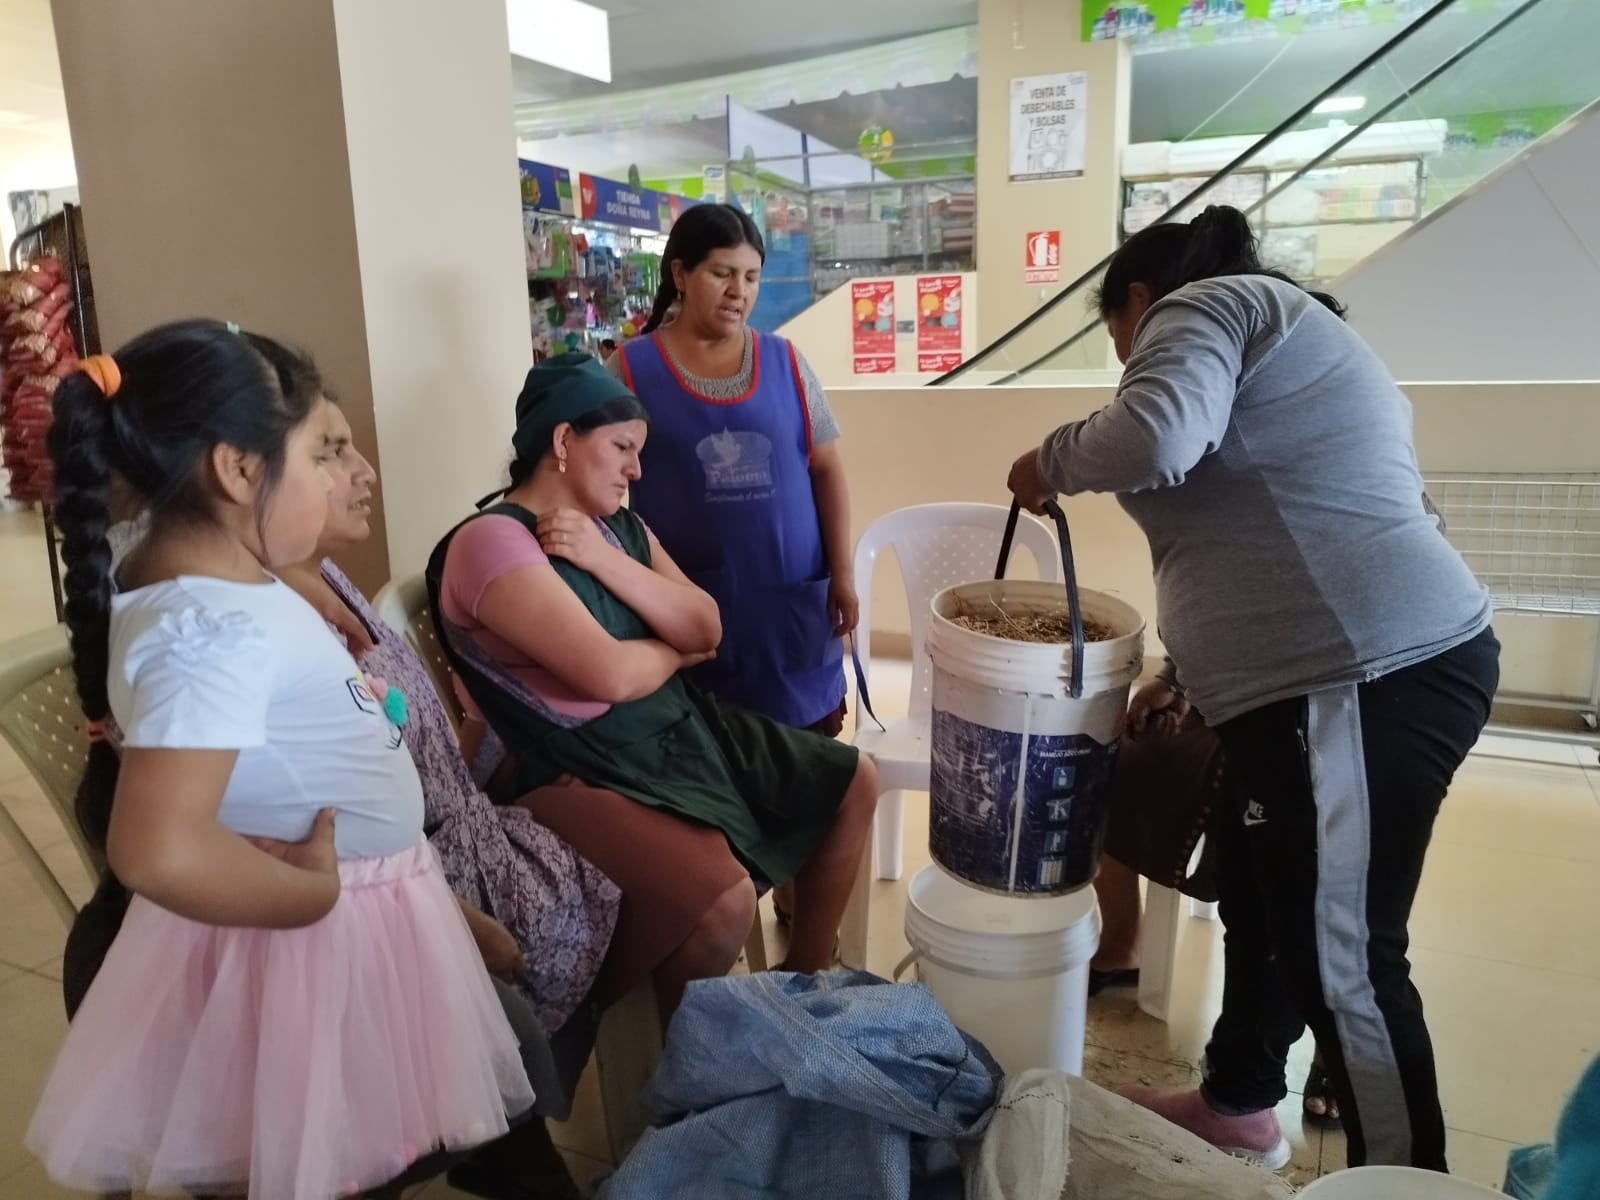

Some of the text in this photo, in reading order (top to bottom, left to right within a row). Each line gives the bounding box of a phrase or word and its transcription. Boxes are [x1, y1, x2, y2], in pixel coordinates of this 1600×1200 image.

[1030, 85, 1067, 99] VENTA DE
[1021, 99, 1075, 115] DESECHABLES
[1029, 114, 1066, 128] Y BOLSAS
[616, 189, 641, 205] TIENDA
[606, 202, 650, 220] DOÑA REYNA
